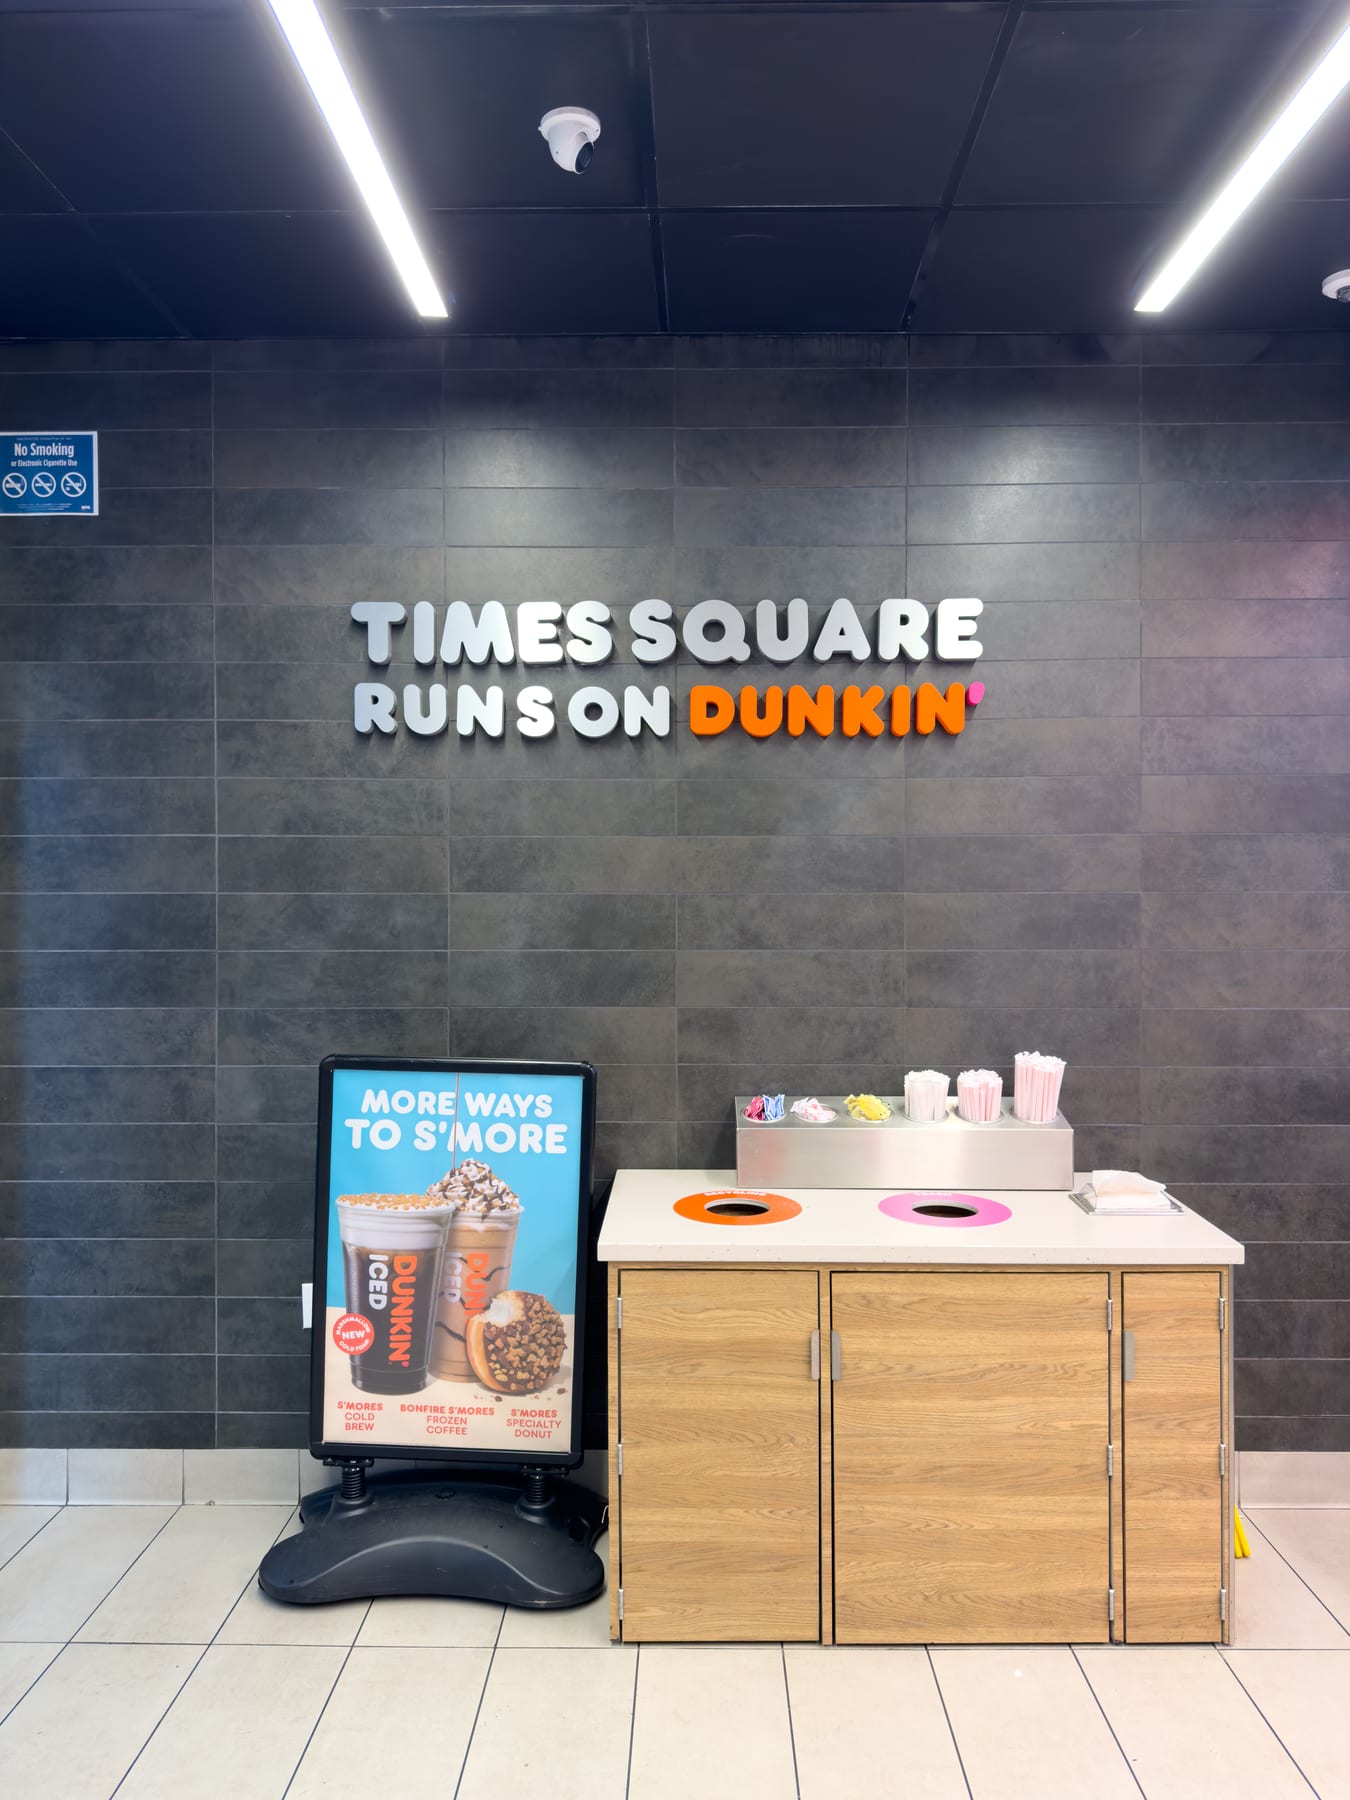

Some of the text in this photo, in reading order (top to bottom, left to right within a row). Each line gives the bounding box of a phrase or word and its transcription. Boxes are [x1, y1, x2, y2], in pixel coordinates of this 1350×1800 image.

[14, 442, 75, 458] No Smoking
[17, 459, 42, 467] Electronic
[43, 459, 67, 468] Cigarette
[67, 459, 78, 467] Use
[350, 598, 985, 665] TIMES SQUARE
[353, 681, 986, 738] RUNS ON DUNKIN'
[361, 1089, 553, 1118] MORE WAYS
[344, 1118, 568, 1154] TO S'MORE
[368, 1254, 389, 1310] ICED
[444, 1252, 462, 1304] ICED
[389, 1255, 417, 1367] DUNKIN'
[335, 1316, 371, 1336] MARSHMALLOW
[341, 1330, 365, 1340] NEW
[339, 1340, 355, 1352] COLD
[337, 1401, 383, 1411] S'MORES
[400, 1404, 495, 1416] BONFIRE S'MORES
[345, 1412, 375, 1421] COLD
[511, 1408, 557, 1418] S'MORES
[426, 1415, 468, 1425] FROZEN
[506, 1418, 561, 1429] SPECIALTY
[345, 1422, 374, 1431] BREW
[426, 1425, 468, 1435] COFFEE
[514, 1429, 552, 1439] DONUT
